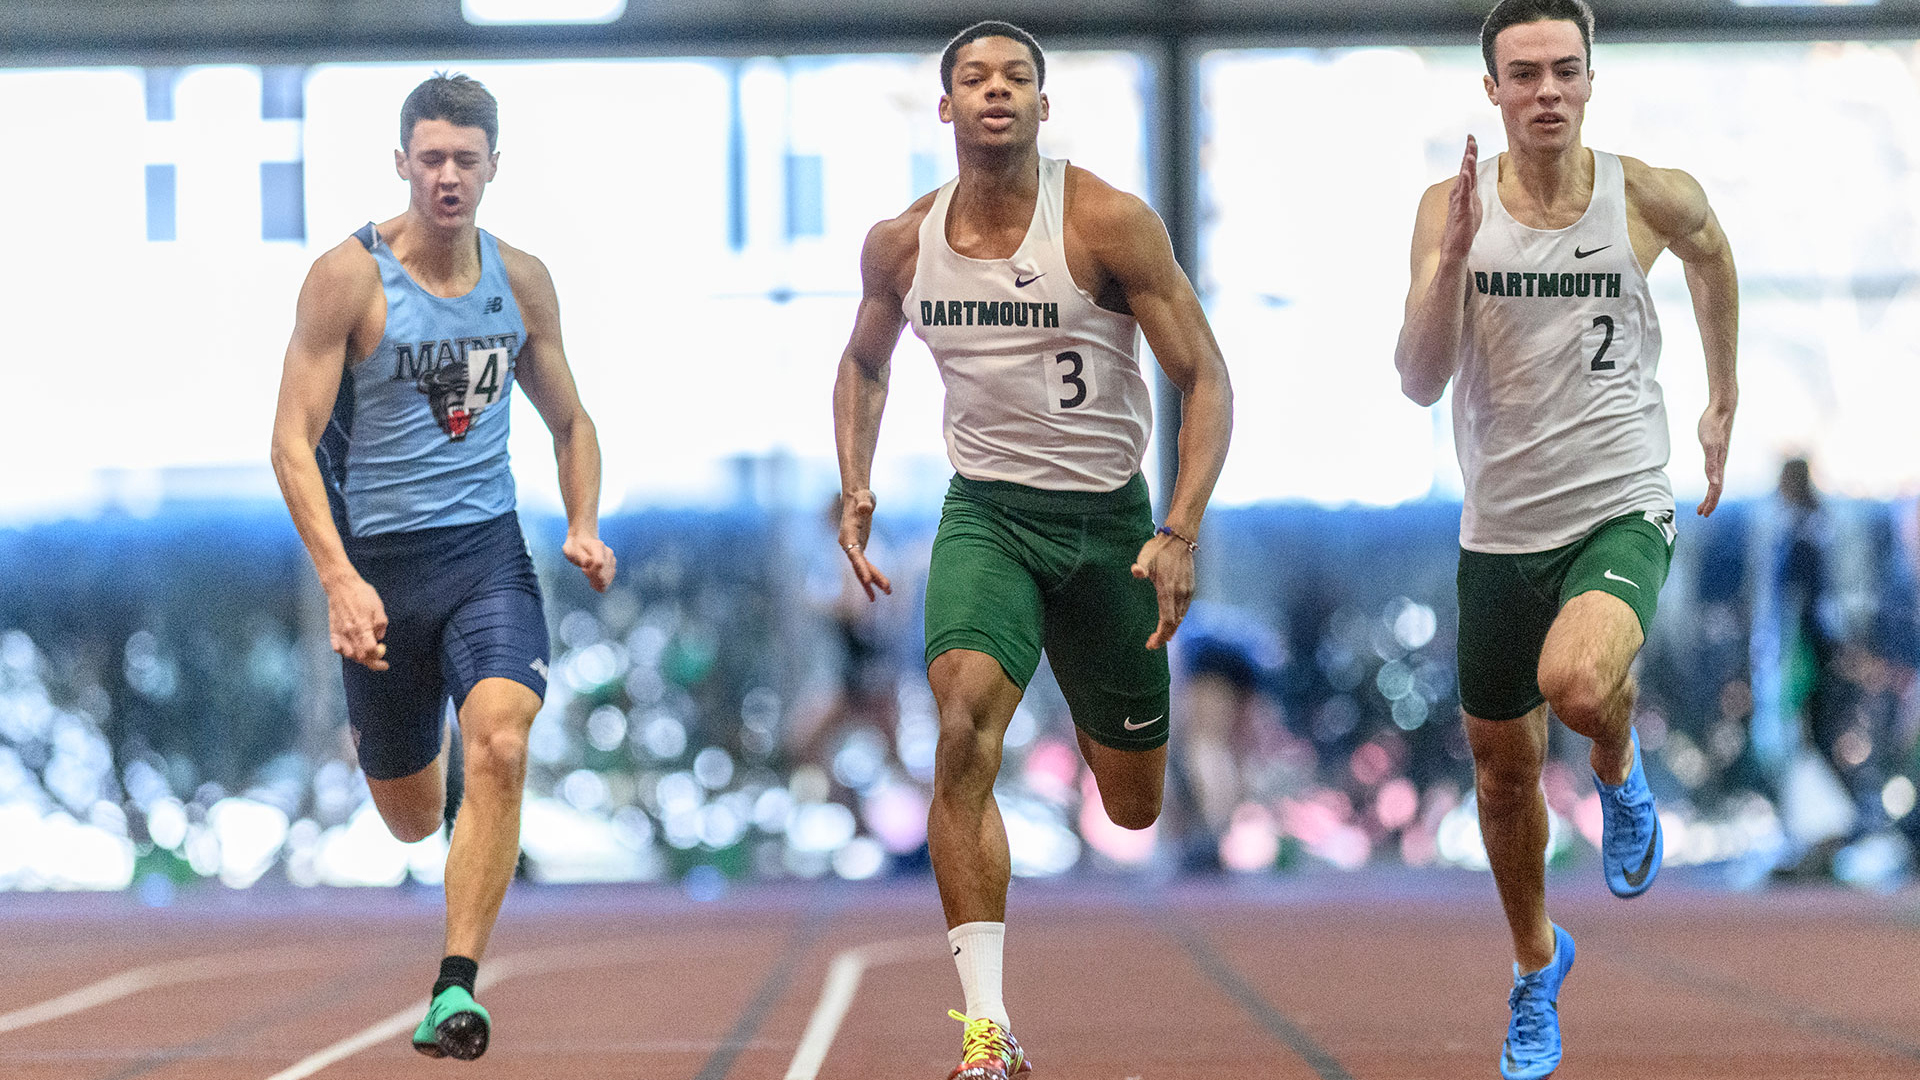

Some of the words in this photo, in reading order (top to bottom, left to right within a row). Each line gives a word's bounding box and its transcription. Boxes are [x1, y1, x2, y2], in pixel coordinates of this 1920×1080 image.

[1474, 271, 1621, 298] DARTMOUTH
[920, 300, 1060, 328] DARTMOUTH
[1590, 314, 1616, 371] 2
[474, 352, 499, 404] 4
[1055, 350, 1087, 409] 3
